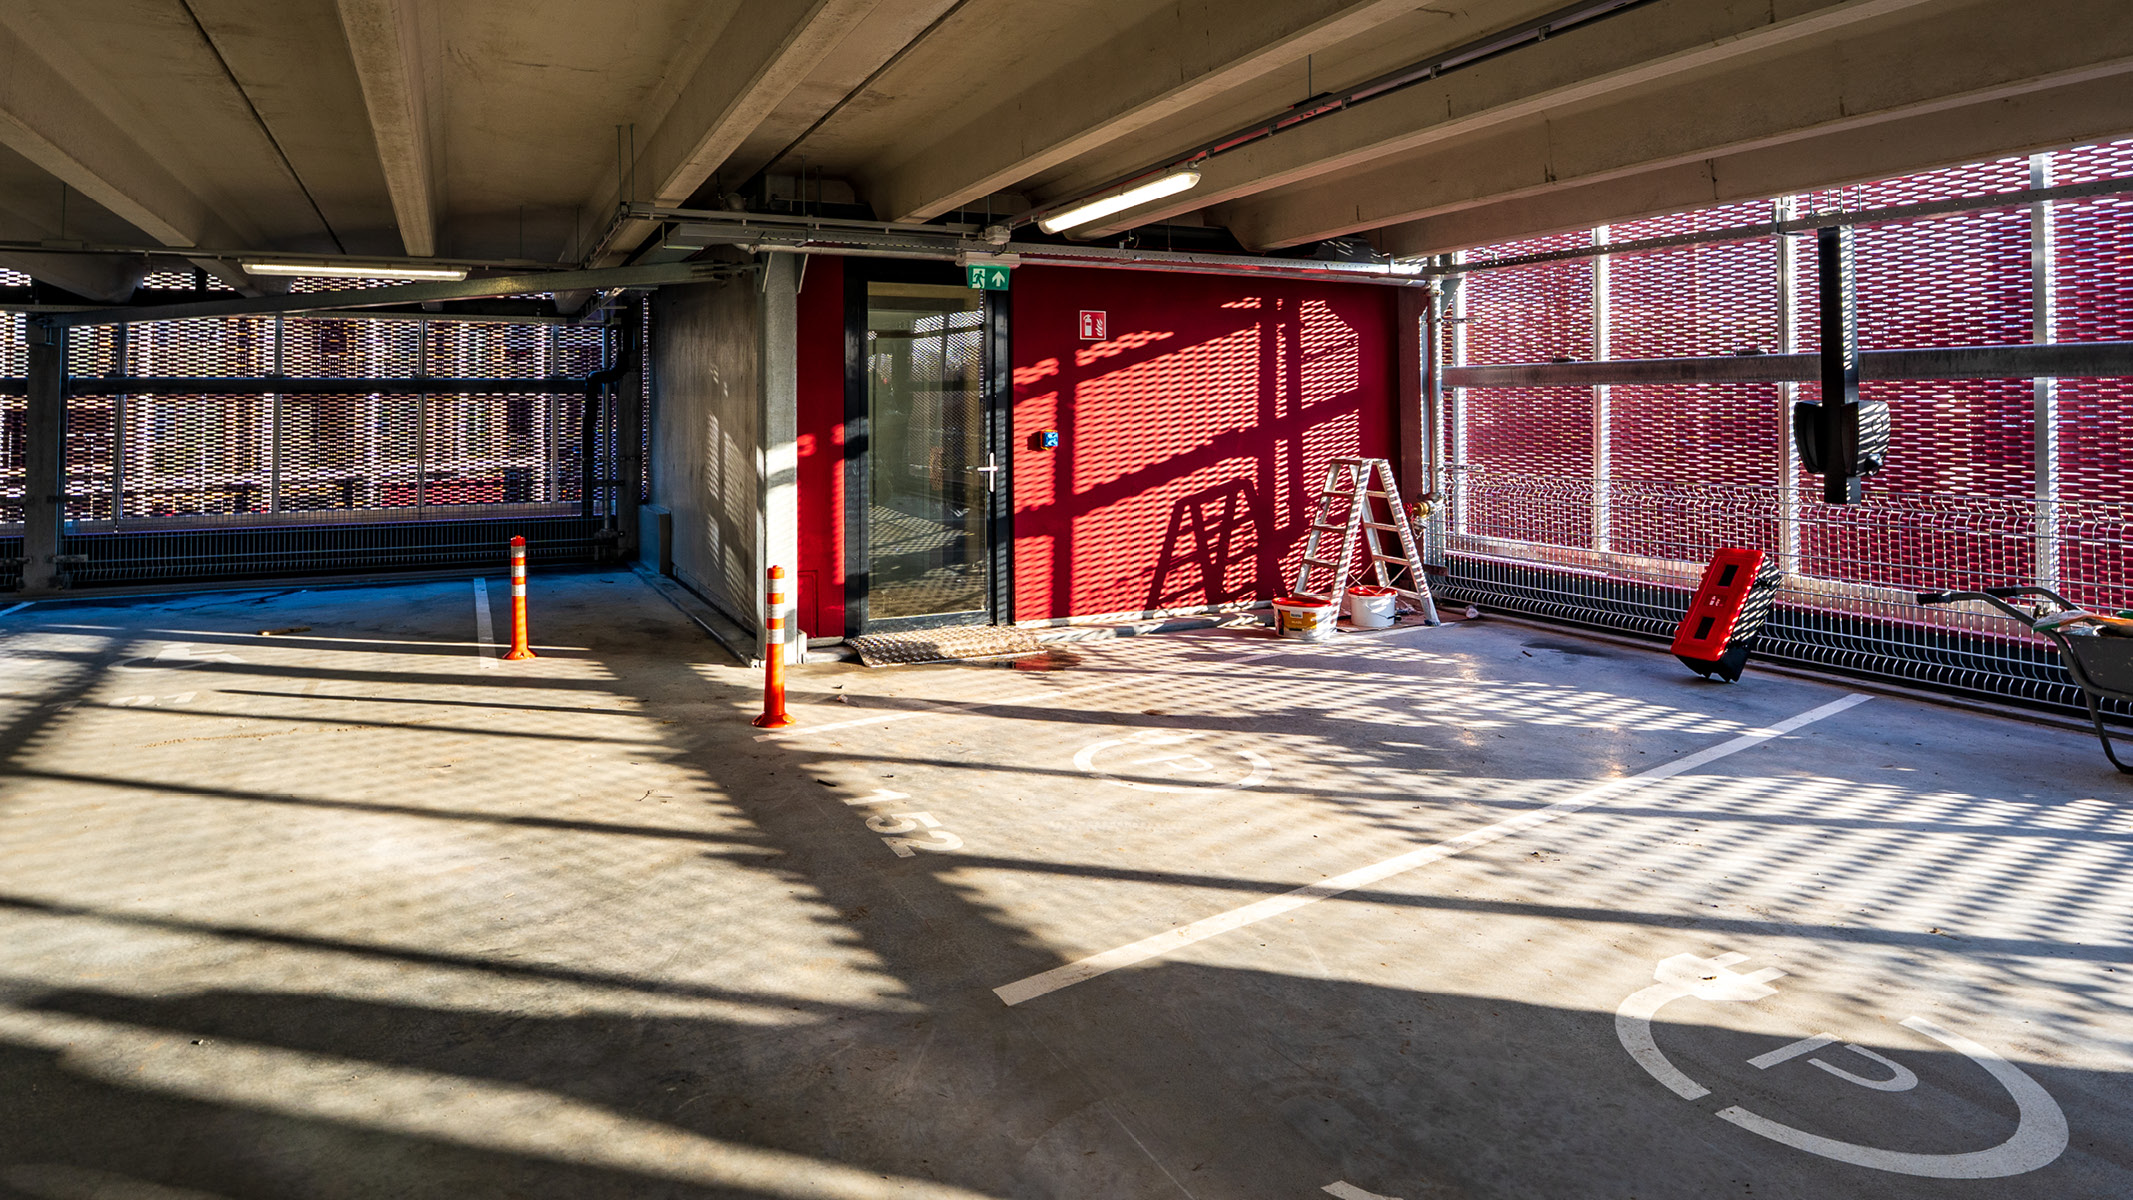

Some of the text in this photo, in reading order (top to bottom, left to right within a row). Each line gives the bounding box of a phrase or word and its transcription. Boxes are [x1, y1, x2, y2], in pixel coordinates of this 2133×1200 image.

[1131, 754, 1214, 772] P
[842, 788, 964, 858] 152
[1746, 1032, 1918, 1092] P
